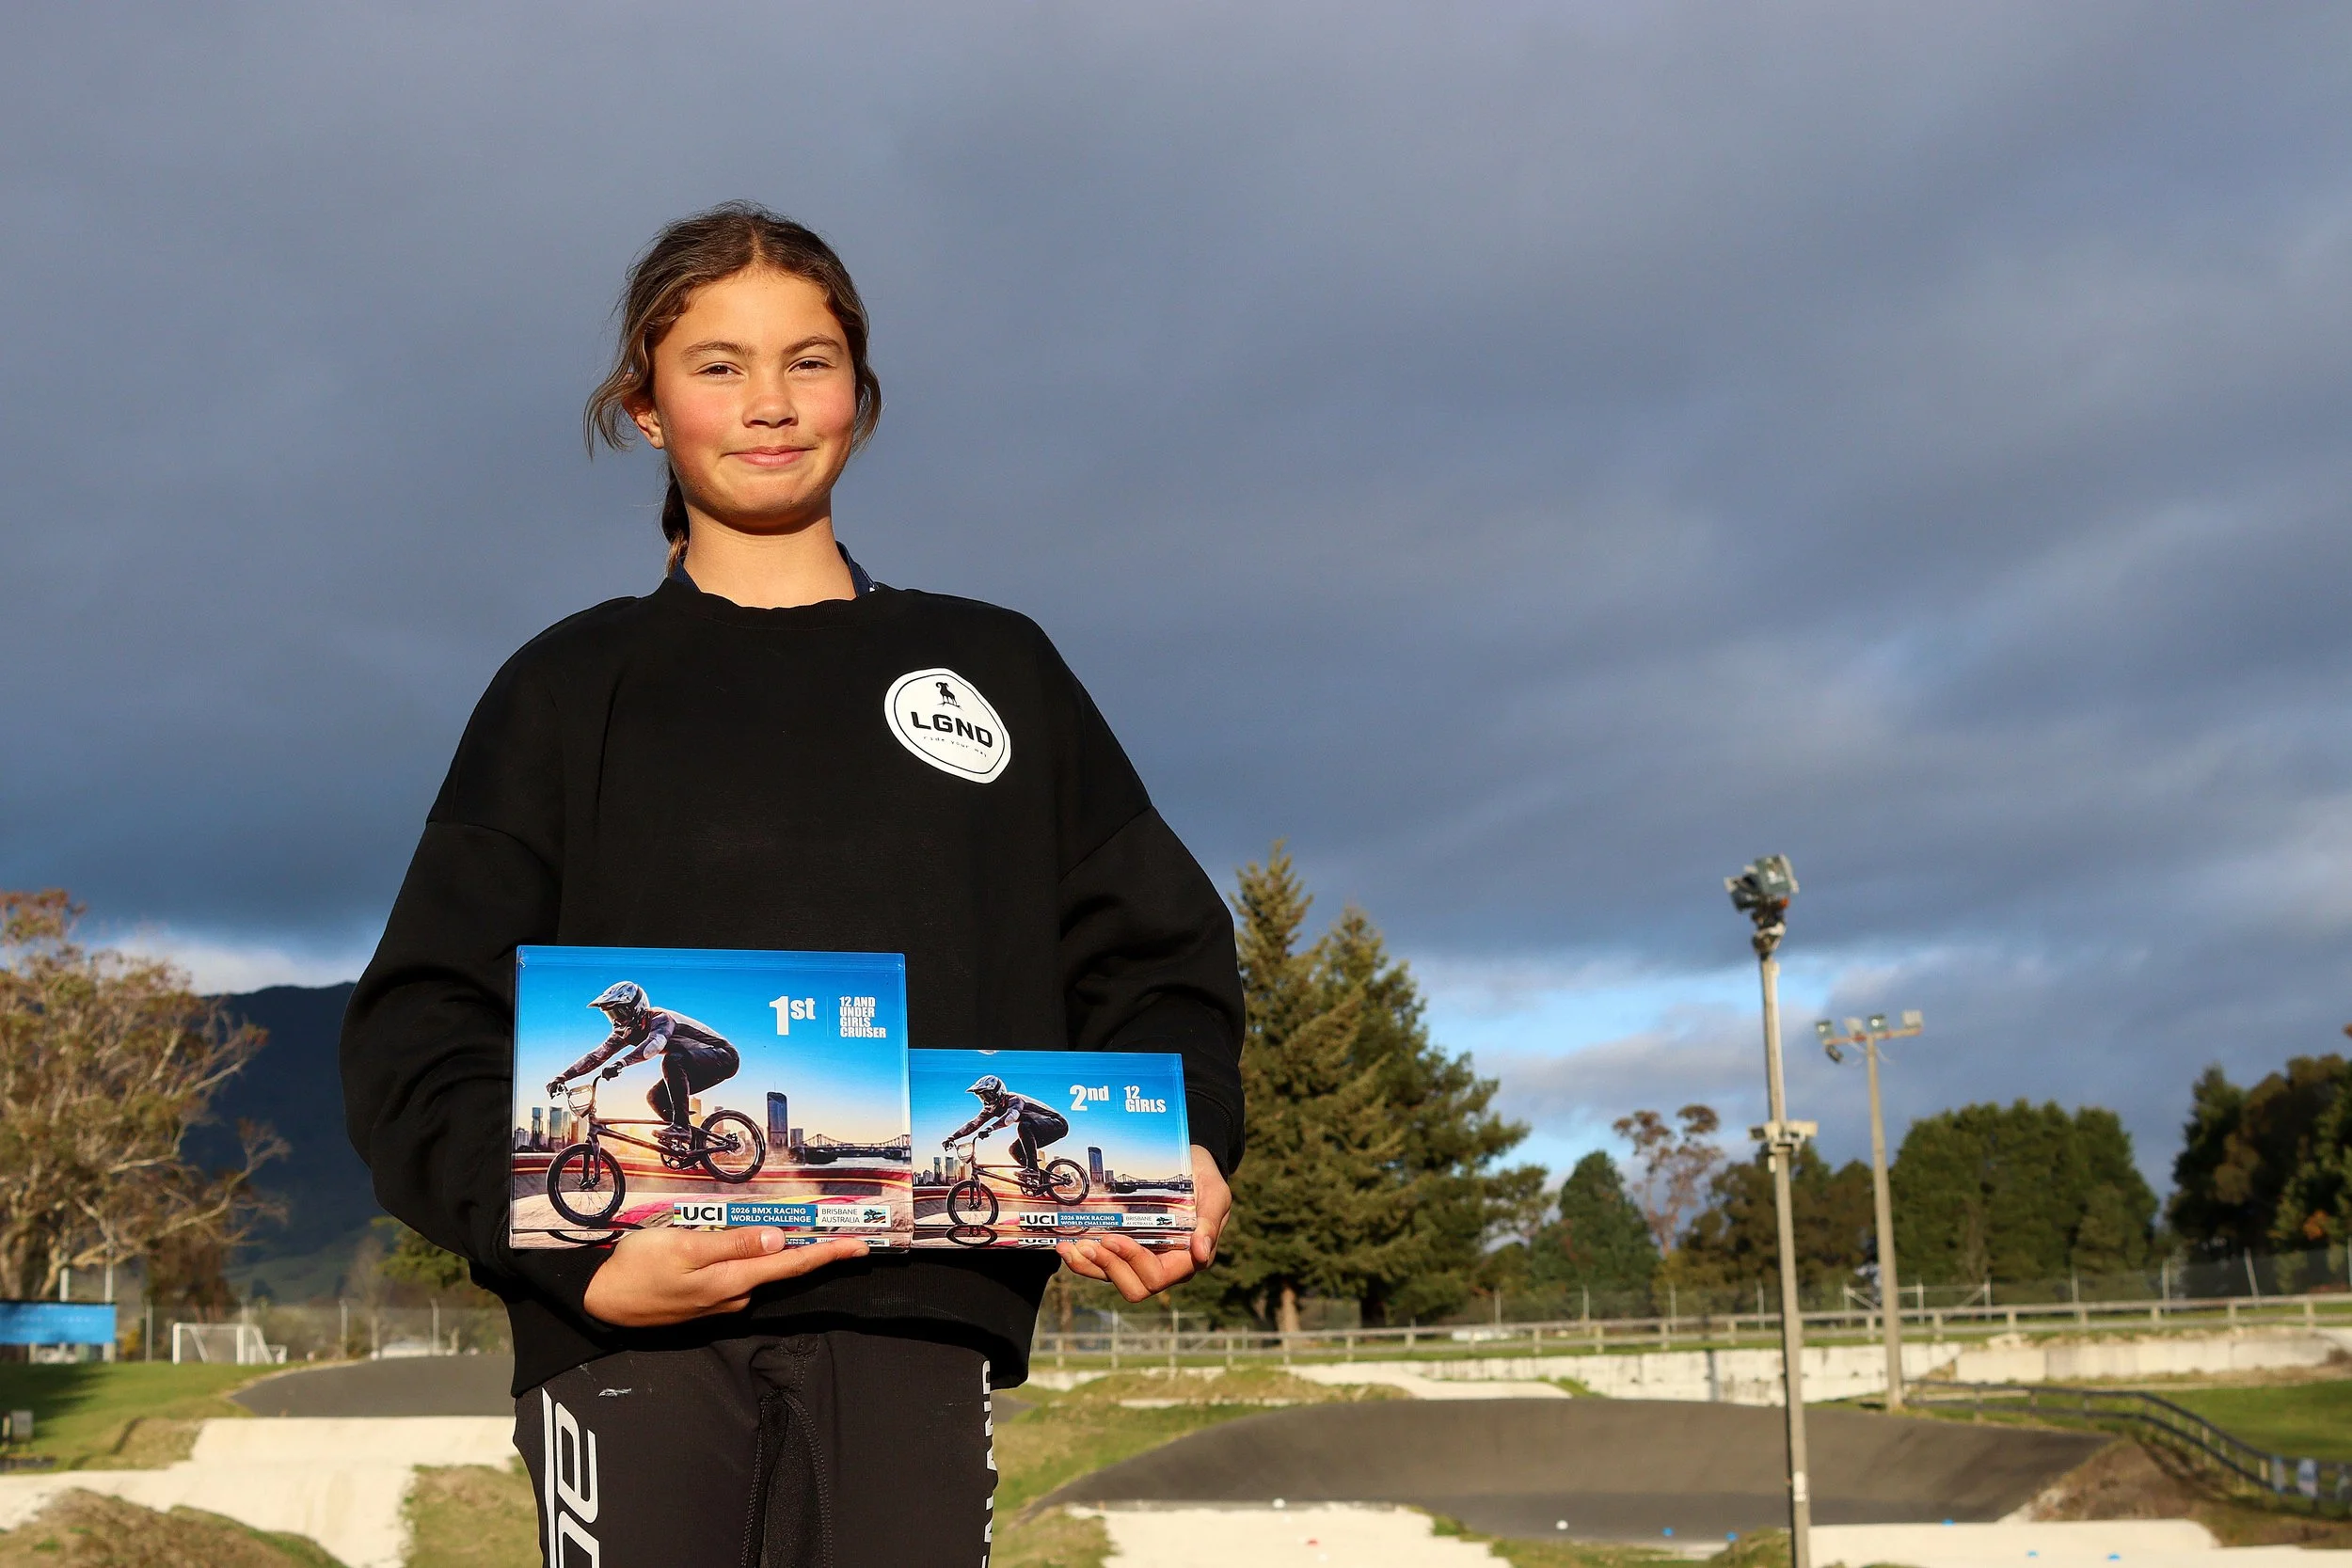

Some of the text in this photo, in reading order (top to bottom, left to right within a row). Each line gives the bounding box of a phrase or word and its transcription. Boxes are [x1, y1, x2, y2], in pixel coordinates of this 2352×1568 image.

[911, 711, 993, 748] LGND
[839, 996, 876, 1007] 12 AND
[769, 996, 816, 1036] 1st
[840, 1006, 875, 1017] UNDER
[840, 1017, 871, 1027] GIRLS
[840, 1027, 887, 1038] CRUISER
[1123, 1085, 1140, 1099] 12
[1070, 1085, 1109, 1111] 2nd
[1125, 1099, 1167, 1113] GIRLS
[683, 1207, 723, 1221] UCI
[731, 1214, 761, 1223] WORLD
[821, 1215, 861, 1224] AUSTRALIA
[1026, 1215, 1056, 1225] UCI
